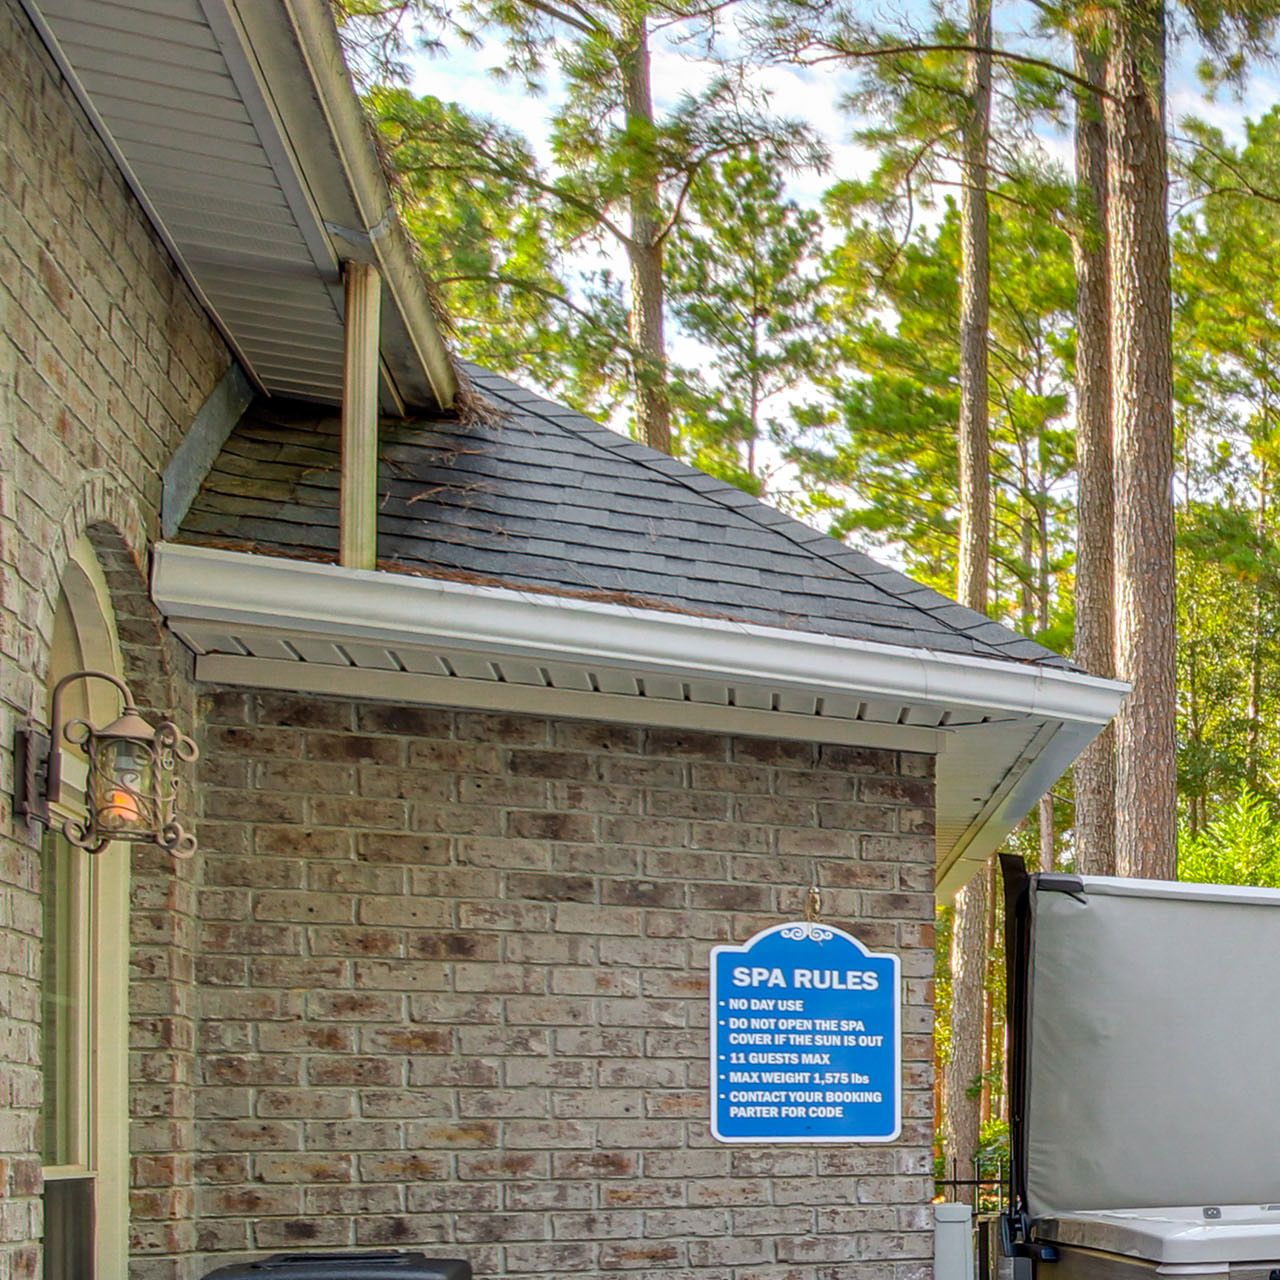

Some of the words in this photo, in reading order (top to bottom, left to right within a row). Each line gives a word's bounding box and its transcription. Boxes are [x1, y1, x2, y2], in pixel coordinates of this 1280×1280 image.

[733, 967, 786, 987] SPA
[794, 969, 878, 990] RULES
[729, 999, 748, 1009] NO
[751, 999, 775, 1010] DAY
[778, 1000, 803, 1011] USE
[729, 1018, 748, 1029] DO
[751, 1019, 776, 1029] NOT
[778, 1019, 812, 1030] OPEN
[814, 1020, 838, 1030] THE
[840, 1020, 865, 1031] SPA
[729, 1033, 772, 1044] COVER
[775, 1034, 787, 1044] IF
[789, 1034, 813, 1045] THE
[814, 1035, 841, 1046] SUN
[844, 1036, 856, 1046] IS
[858, 1036, 883, 1046] OUT
[730, 1053, 746, 1063] 11
[749, 1053, 799, 1064] GUESTS
[802, 1054, 830, 1064] MAX
[730, 1072, 759, 1083] MAX
[762, 1072, 811, 1083] WEIGHT
[814, 1073, 849, 1085] 1,575
[851, 1073, 869, 1083] lbs
[730, 1091, 787, 1102] CONTACT
[789, 1092, 823, 1102] YOUR
[826, 1092, 882, 1102] BOOKING
[730, 1107, 778, 1117] PARTER
[781, 1107, 806, 1117] FOR
[808, 1107, 843, 1117] CODE
